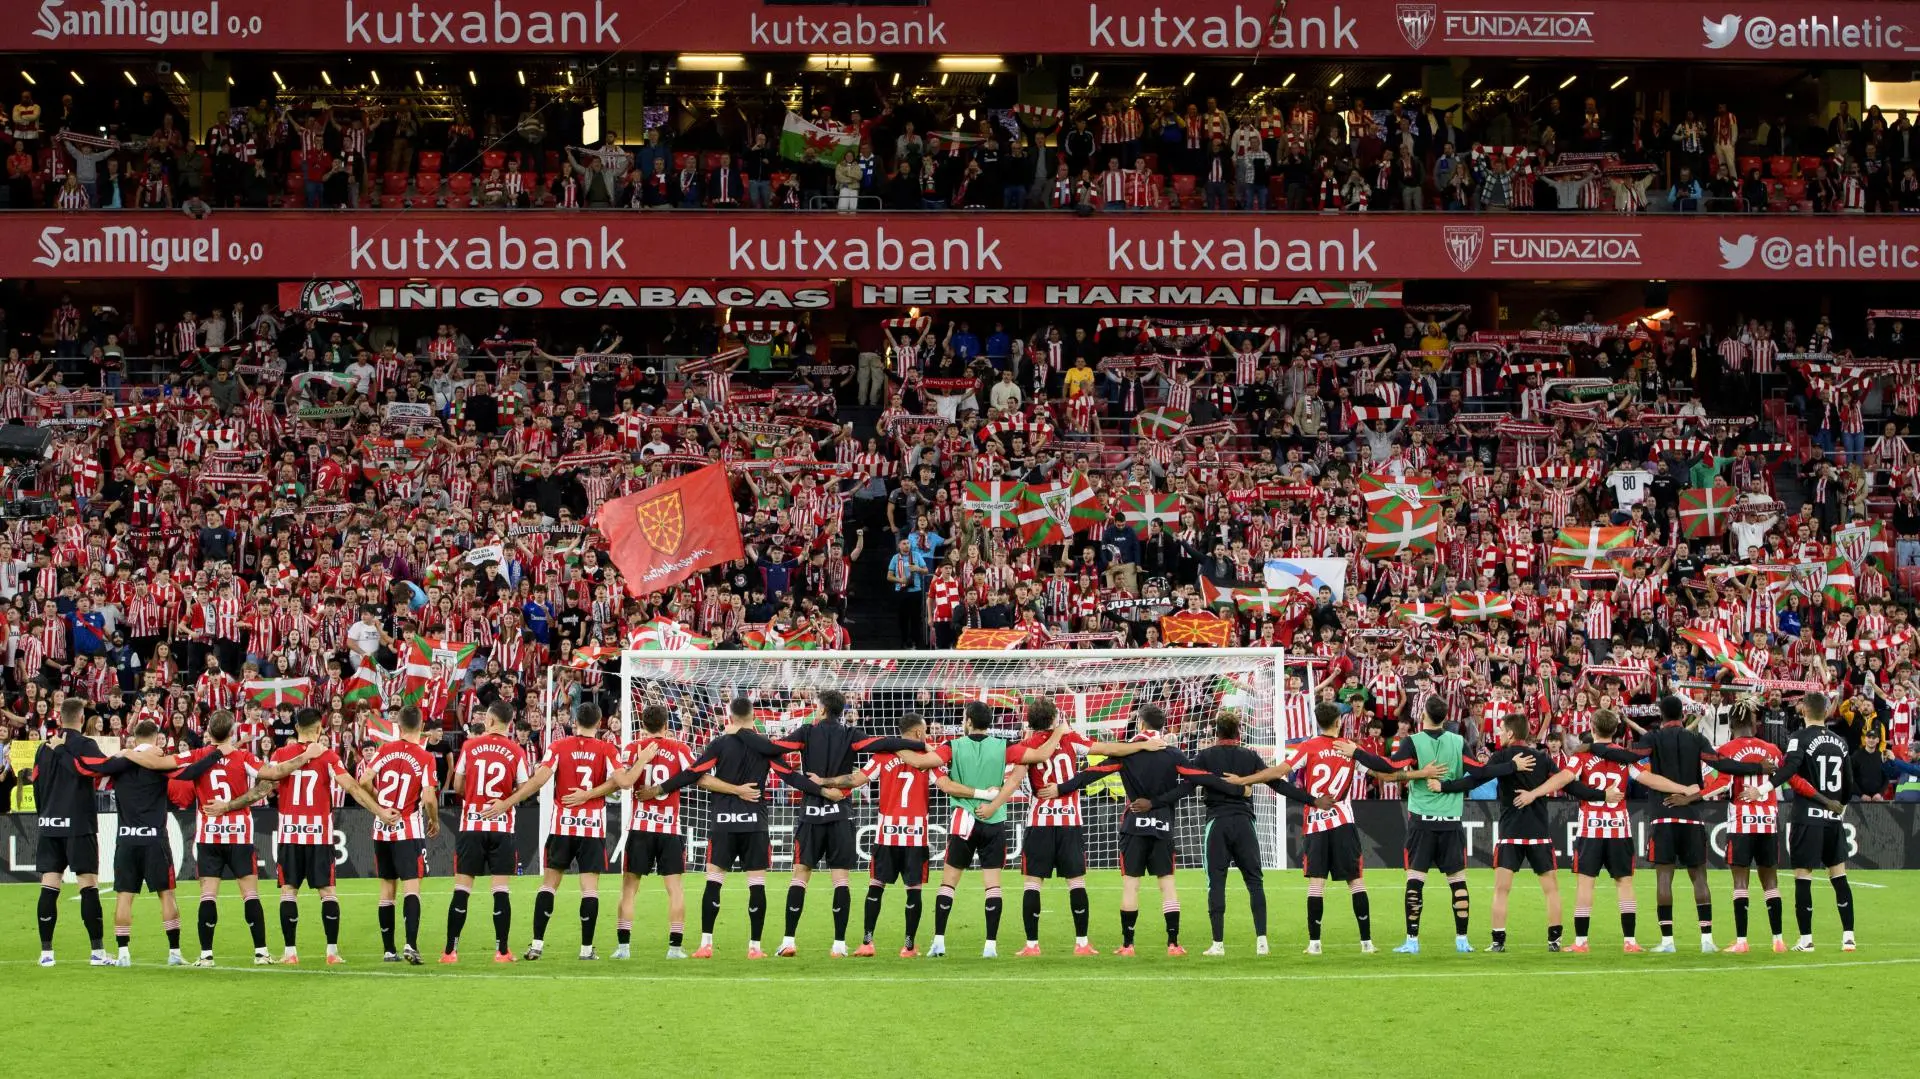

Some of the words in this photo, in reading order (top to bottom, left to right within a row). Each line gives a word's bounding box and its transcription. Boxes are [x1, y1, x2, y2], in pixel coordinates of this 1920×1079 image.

[228, 16, 262, 38] 0,0
[346, 0, 621, 44] kutxabank
[751, 13, 947, 45] kutxabank
[1090, 5, 1358, 48] kutxabank
[1446, 16, 1593, 37] FUNDAZIOA
[228, 243, 263, 265] 0,0
[350, 226, 626, 270] kutxabank
[729, 227, 1002, 271] kutxabank
[1108, 227, 1378, 271] kutxabank
[1493, 238, 1641, 259] FUNDAZIOA
[1760, 235, 1920, 270] @athletic
[379, 284, 543, 307] IÑIGO
[560, 287, 830, 307] CABACAS
[863, 285, 1027, 304] HERRI
[1045, 286, 1325, 305] HARMAILA
[1579, 386, 1609, 394] ATHLETIC
[1612, 384, 1632, 392] CLUB
[1622, 475, 1636, 490] 80
[1107, 597, 1170, 610] JUSTIZIA
[472, 744, 515, 762] GURUZETA
[1733, 746, 1767, 762] WILLIAMS
[1806, 734, 1848, 758] AGIRREZABALA
[474, 759, 506, 798] 12
[576, 766, 593, 791] 3
[1037, 752, 1075, 785] 20
[1816, 755, 1843, 792] 13
[210, 769, 232, 803] 5
[291, 769, 319, 806] 17
[378, 769, 412, 810] 21
[898, 771, 915, 808] 7
[1311, 763, 1351, 800] 24
[561, 815, 601, 827] DIGI
[635, 811, 674, 825] DIGI
[717, 813, 758, 823] DIGI
[806, 803, 840, 817] DIGI
[1039, 805, 1076, 816] DIGI
[38, 817, 71, 828] DIGI
[119, 826, 157, 837] DIGI
[206, 823, 246, 834] DIGI
[284, 823, 323, 834] DIGI
[883, 824, 923, 836] DIGI
[1588, 818, 1625, 829] DIGI
